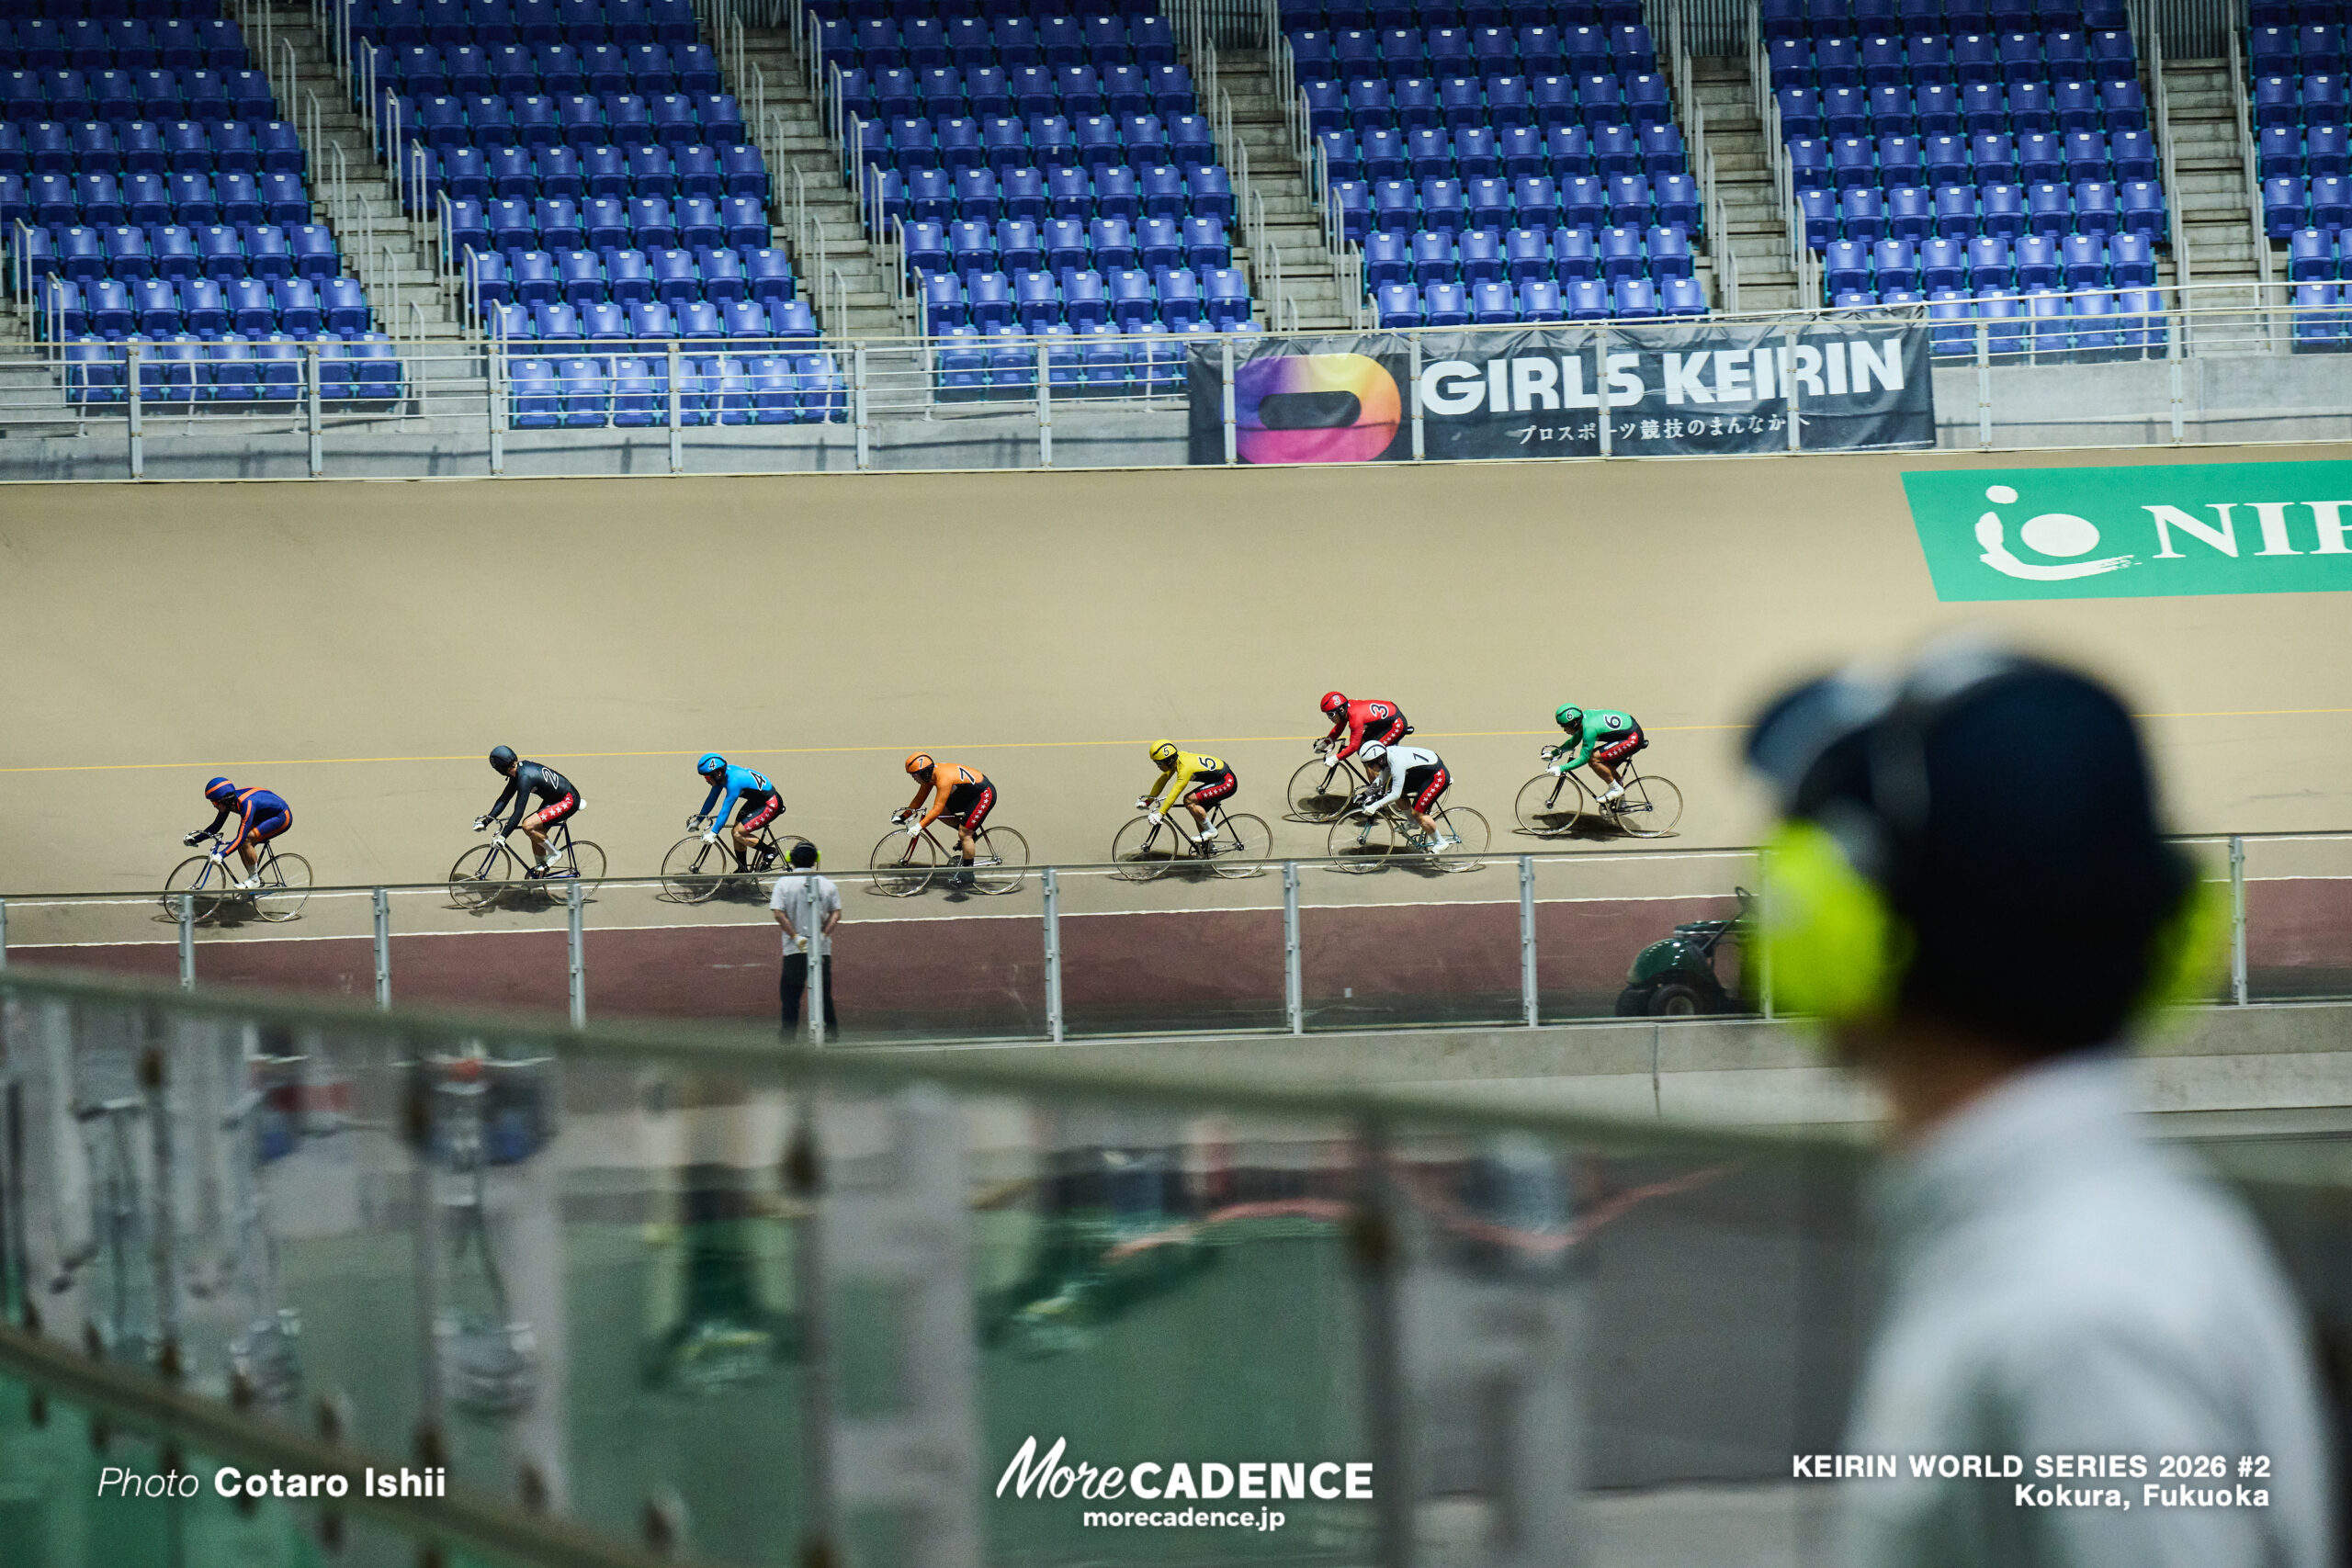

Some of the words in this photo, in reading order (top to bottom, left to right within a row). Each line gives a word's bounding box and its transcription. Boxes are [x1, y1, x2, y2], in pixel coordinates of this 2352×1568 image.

[1421, 353, 1645, 415] GIRLS
[1663, 338, 1905, 404] KEIRIN
[1332, 694, 1340, 705] 3
[1370, 703, 1388, 719] 3
[1566, 710, 1573, 721] 6
[1604, 714, 1622, 729] 6
[1163, 746, 1170, 757] 5
[1412, 752, 1430, 762] 1
[708, 759, 717, 770] 4
[917, 757, 924, 769] 7
[1198, 756, 1216, 771] 5
[542, 767, 559, 790] 2
[749, 770, 766, 791] 4
[956, 765, 976, 784] 7
